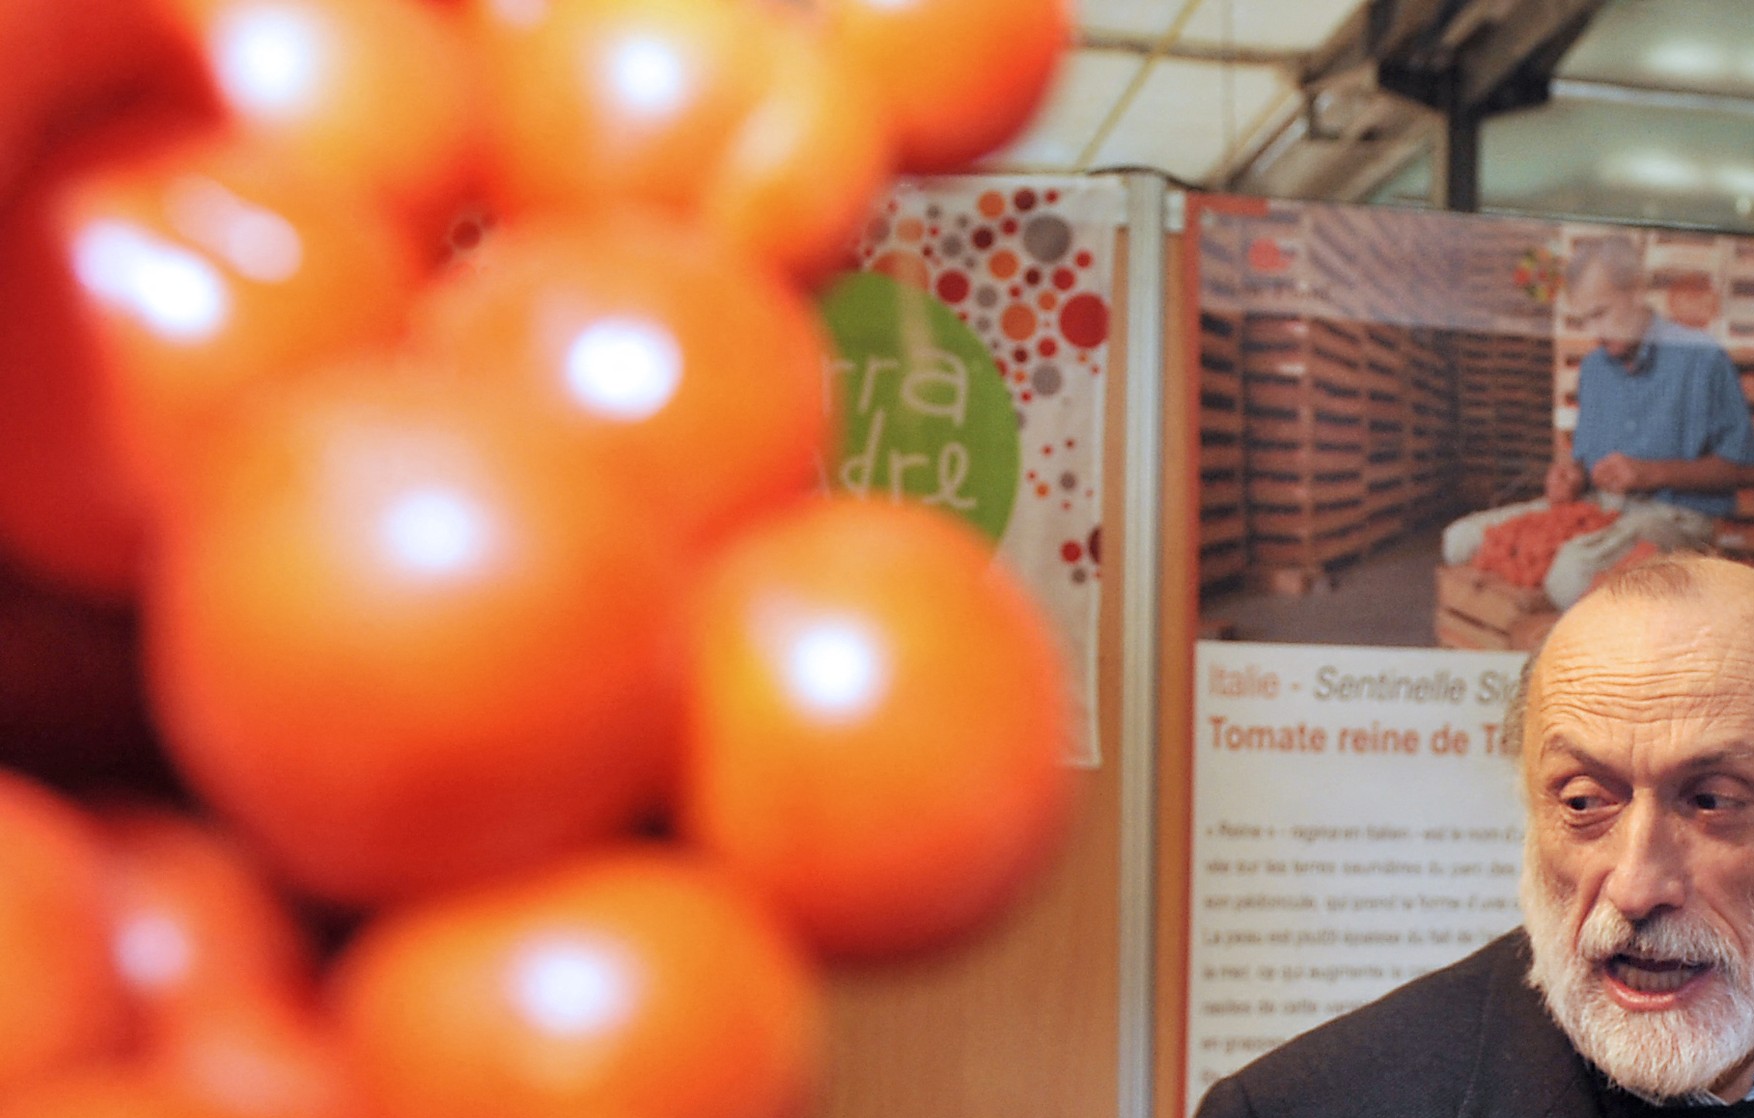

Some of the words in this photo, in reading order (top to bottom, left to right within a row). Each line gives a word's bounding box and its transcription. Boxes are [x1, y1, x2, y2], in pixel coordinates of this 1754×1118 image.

[1208, 663, 1281, 701] Italie
[1313, 665, 1468, 705] Sentinelle
[1208, 715, 1328, 753] Tomate
[1337, 719, 1421, 756] reine
[1427, 721, 1471, 758] de
